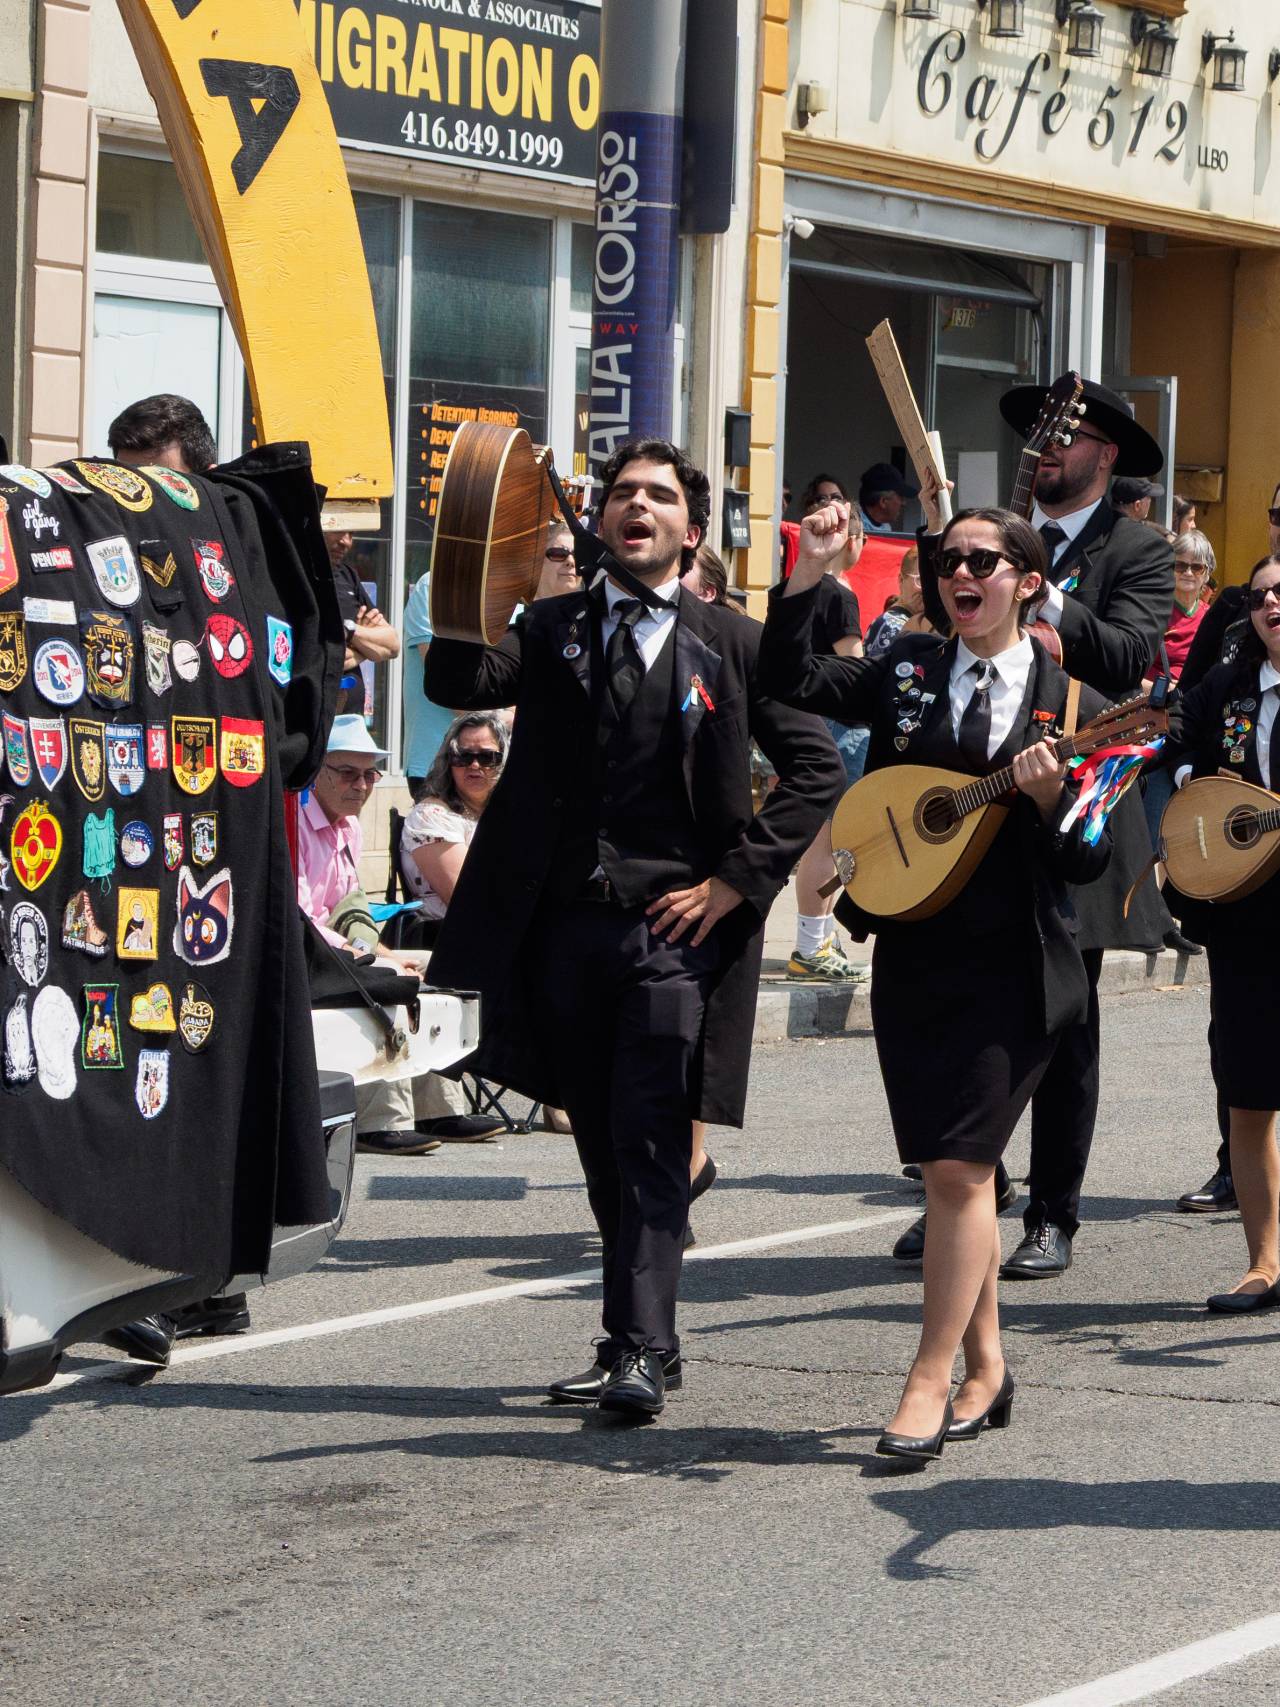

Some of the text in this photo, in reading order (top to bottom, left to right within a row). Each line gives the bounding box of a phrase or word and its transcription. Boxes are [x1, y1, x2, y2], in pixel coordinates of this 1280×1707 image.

[467, 0, 481, 18] &
[484, 0, 580, 41] ASSOCIATES
[917, 29, 1188, 162] Café 512
[400, 111, 563, 168] 416.849.1999
[1198, 146, 1229, 171] LLBO
[594, 131, 640, 305] CORSO
[430, 404, 519, 427] DETENTION HEARINGS
